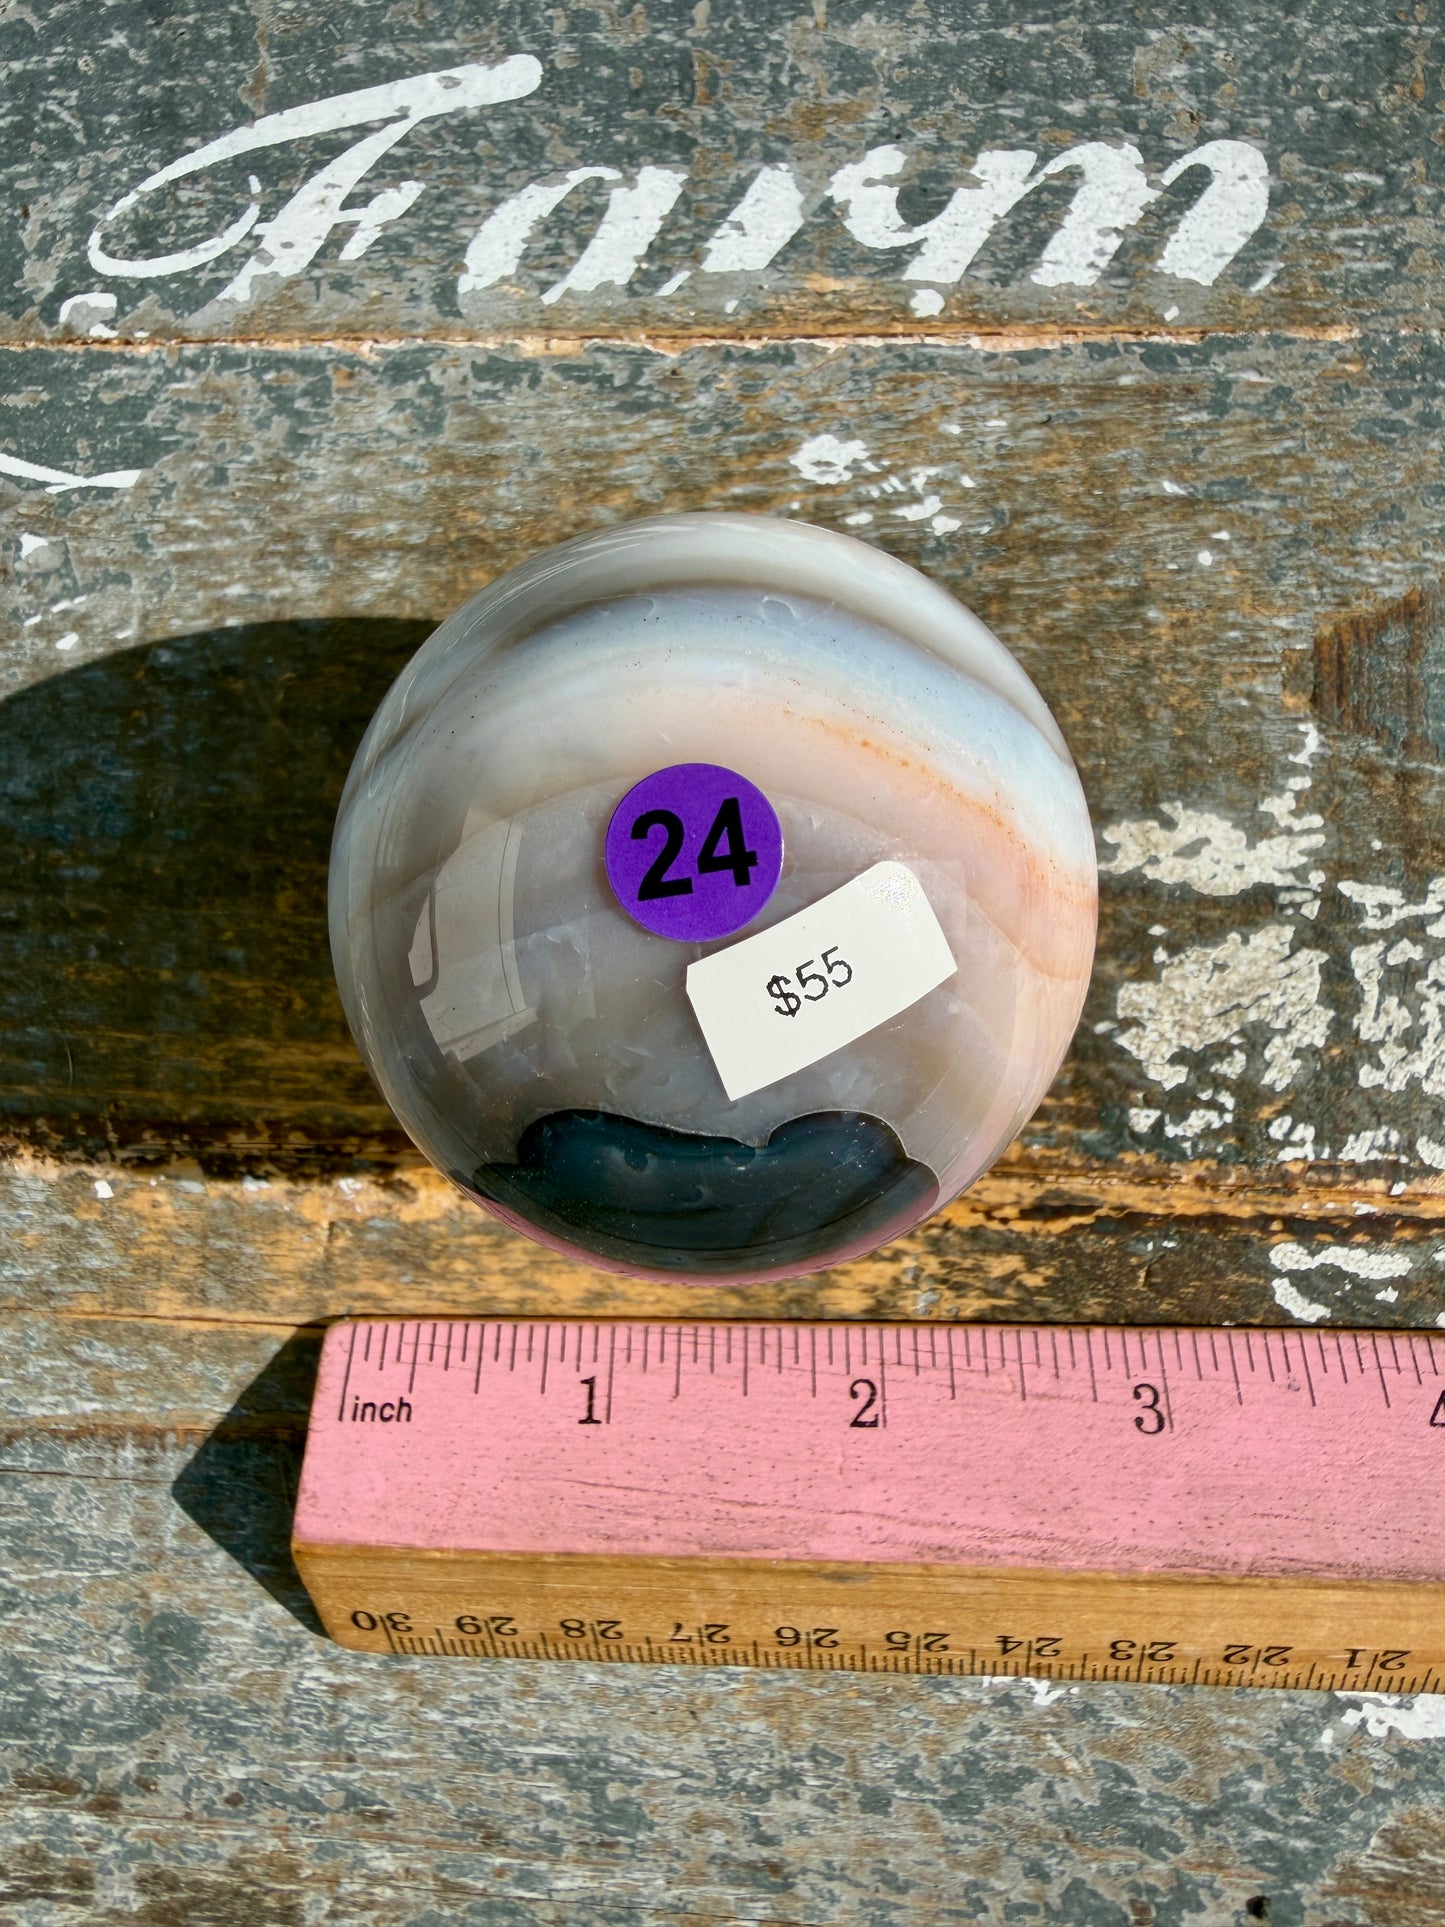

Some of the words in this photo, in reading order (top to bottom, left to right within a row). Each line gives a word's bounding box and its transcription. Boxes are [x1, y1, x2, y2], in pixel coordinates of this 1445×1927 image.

[630, 797, 758, 902] 24
[766, 946, 852, 1017] $55
[351, 1396, 412, 1424] inch
[577, 1376, 602, 1426] 1
[849, 1378, 879, 1429] 2
[1133, 1383, 1165, 1434] 3
[351, 1610, 414, 1633] 30
[456, 1614, 518, 1636] 29
[560, 1618, 625, 1640] 28
[670, 1622, 731, 1645] 27
[775, 1626, 840, 1649] 26
[884, 1630, 952, 1653] 25
[994, 1634, 1063, 1657] 24
[1109, 1639, 1178, 1662] 23
[1222, 1643, 1295, 1667] 22
[1344, 1647, 1412, 1671] 21
